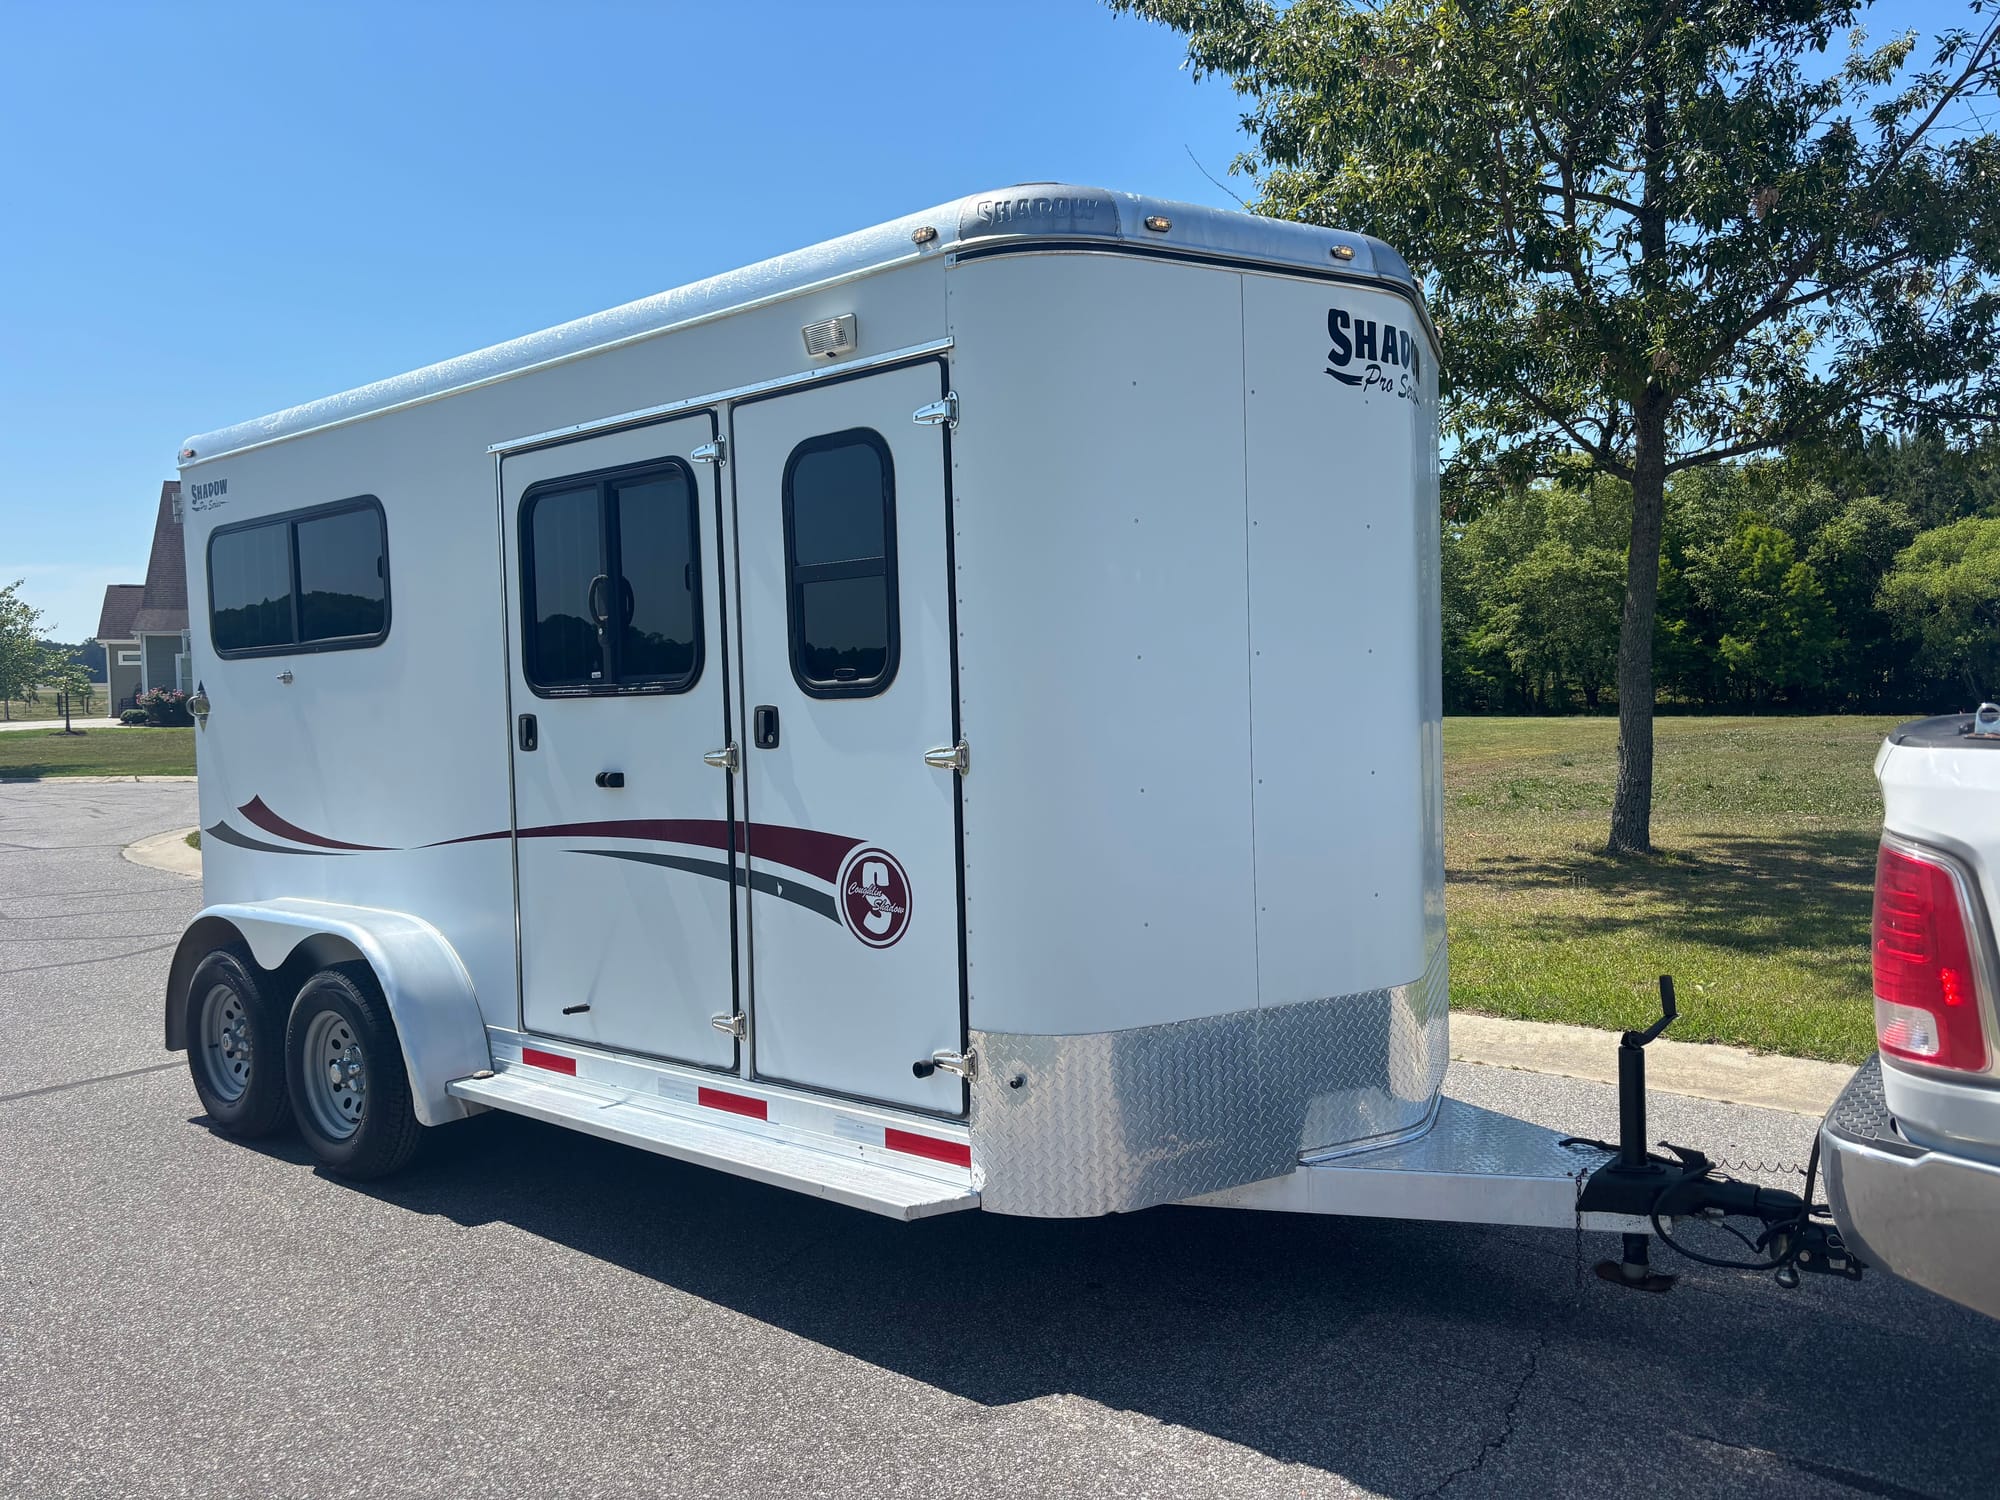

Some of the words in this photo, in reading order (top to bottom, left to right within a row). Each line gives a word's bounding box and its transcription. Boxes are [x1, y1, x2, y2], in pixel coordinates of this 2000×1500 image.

[977, 197, 1098, 226] SHADOW
[1363, 363, 1393, 392] Pro
[191, 479, 228, 504] SHADOW
